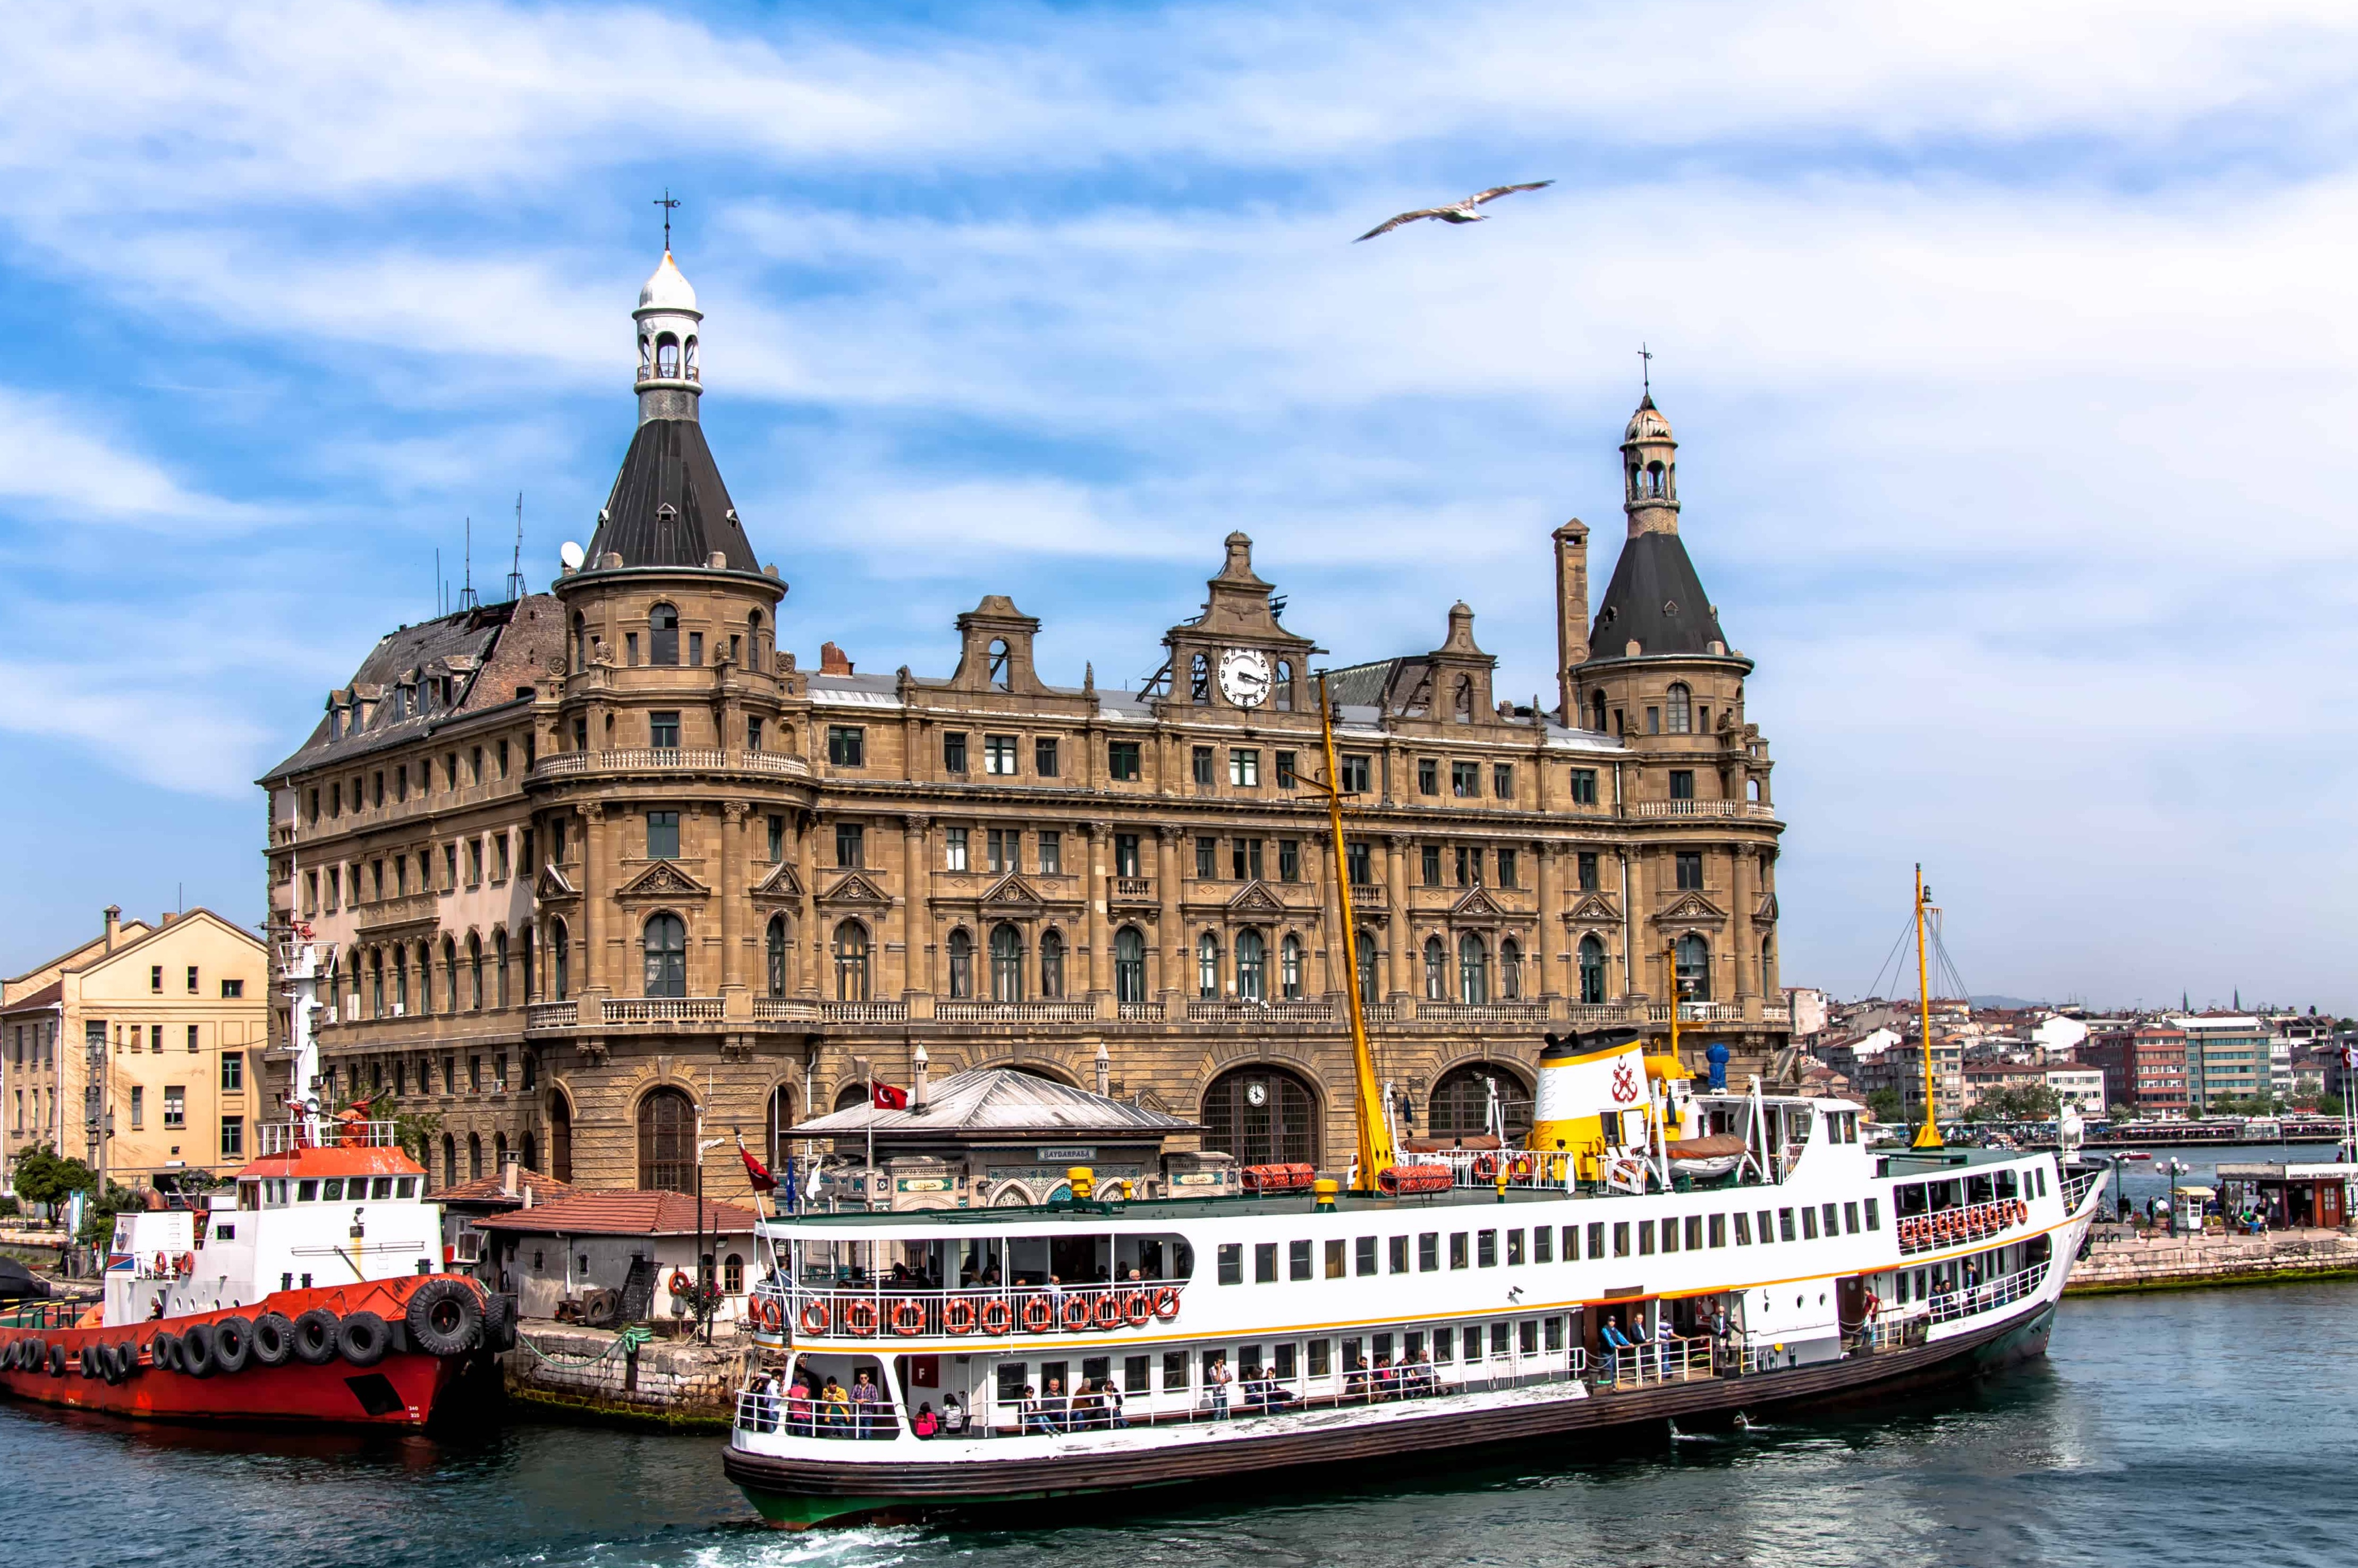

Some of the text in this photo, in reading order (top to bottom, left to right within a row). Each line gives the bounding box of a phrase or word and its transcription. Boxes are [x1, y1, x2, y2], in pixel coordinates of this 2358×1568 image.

[1223, 657, 1229, 665] 10
[1263, 674, 1269, 682] 3
[1224, 684, 1228, 692] 8
[1243, 697, 1248, 707] 6
[1254, 695, 1259, 703] 5
[919, 1368, 925, 1379] F
